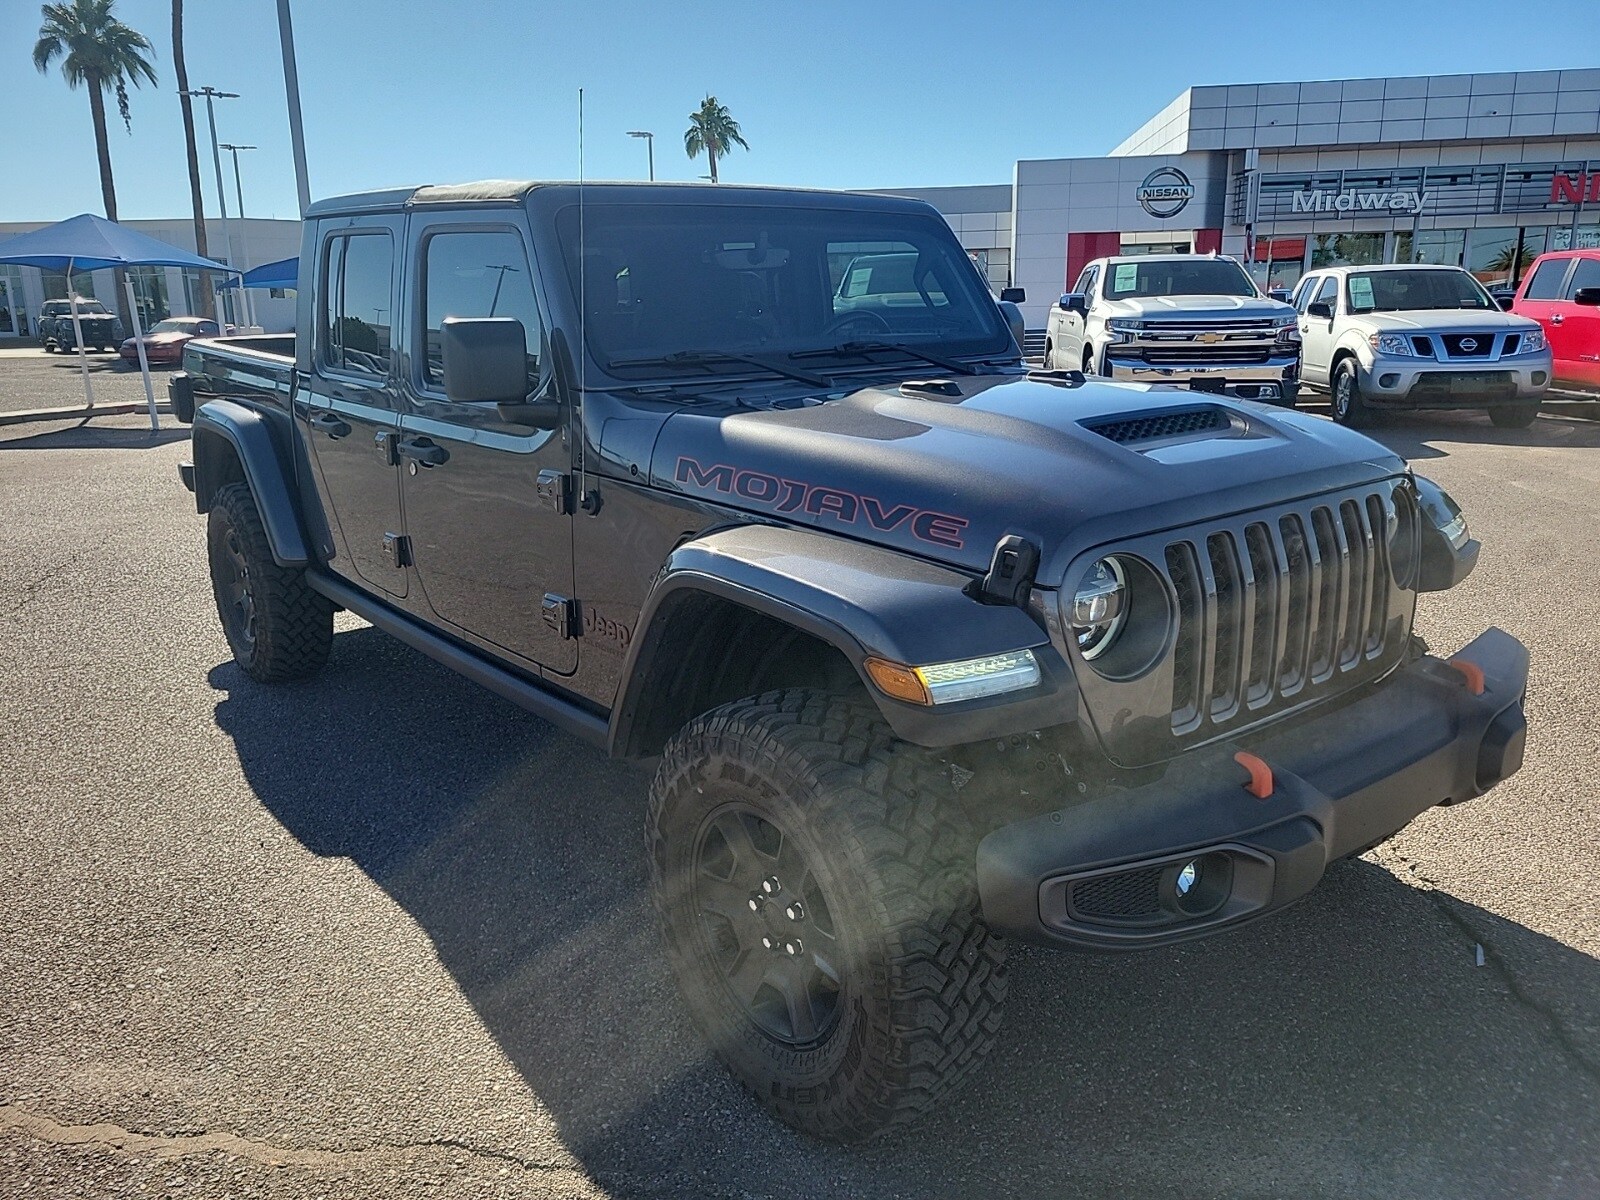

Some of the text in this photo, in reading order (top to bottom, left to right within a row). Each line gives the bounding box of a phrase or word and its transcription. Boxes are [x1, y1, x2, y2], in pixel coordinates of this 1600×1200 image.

[1143, 188, 1189, 198] NISSAN
[1292, 171, 1600, 213] Midway NI
[674, 456, 969, 549] MOJAVE
[583, 606, 630, 650] Jeep
